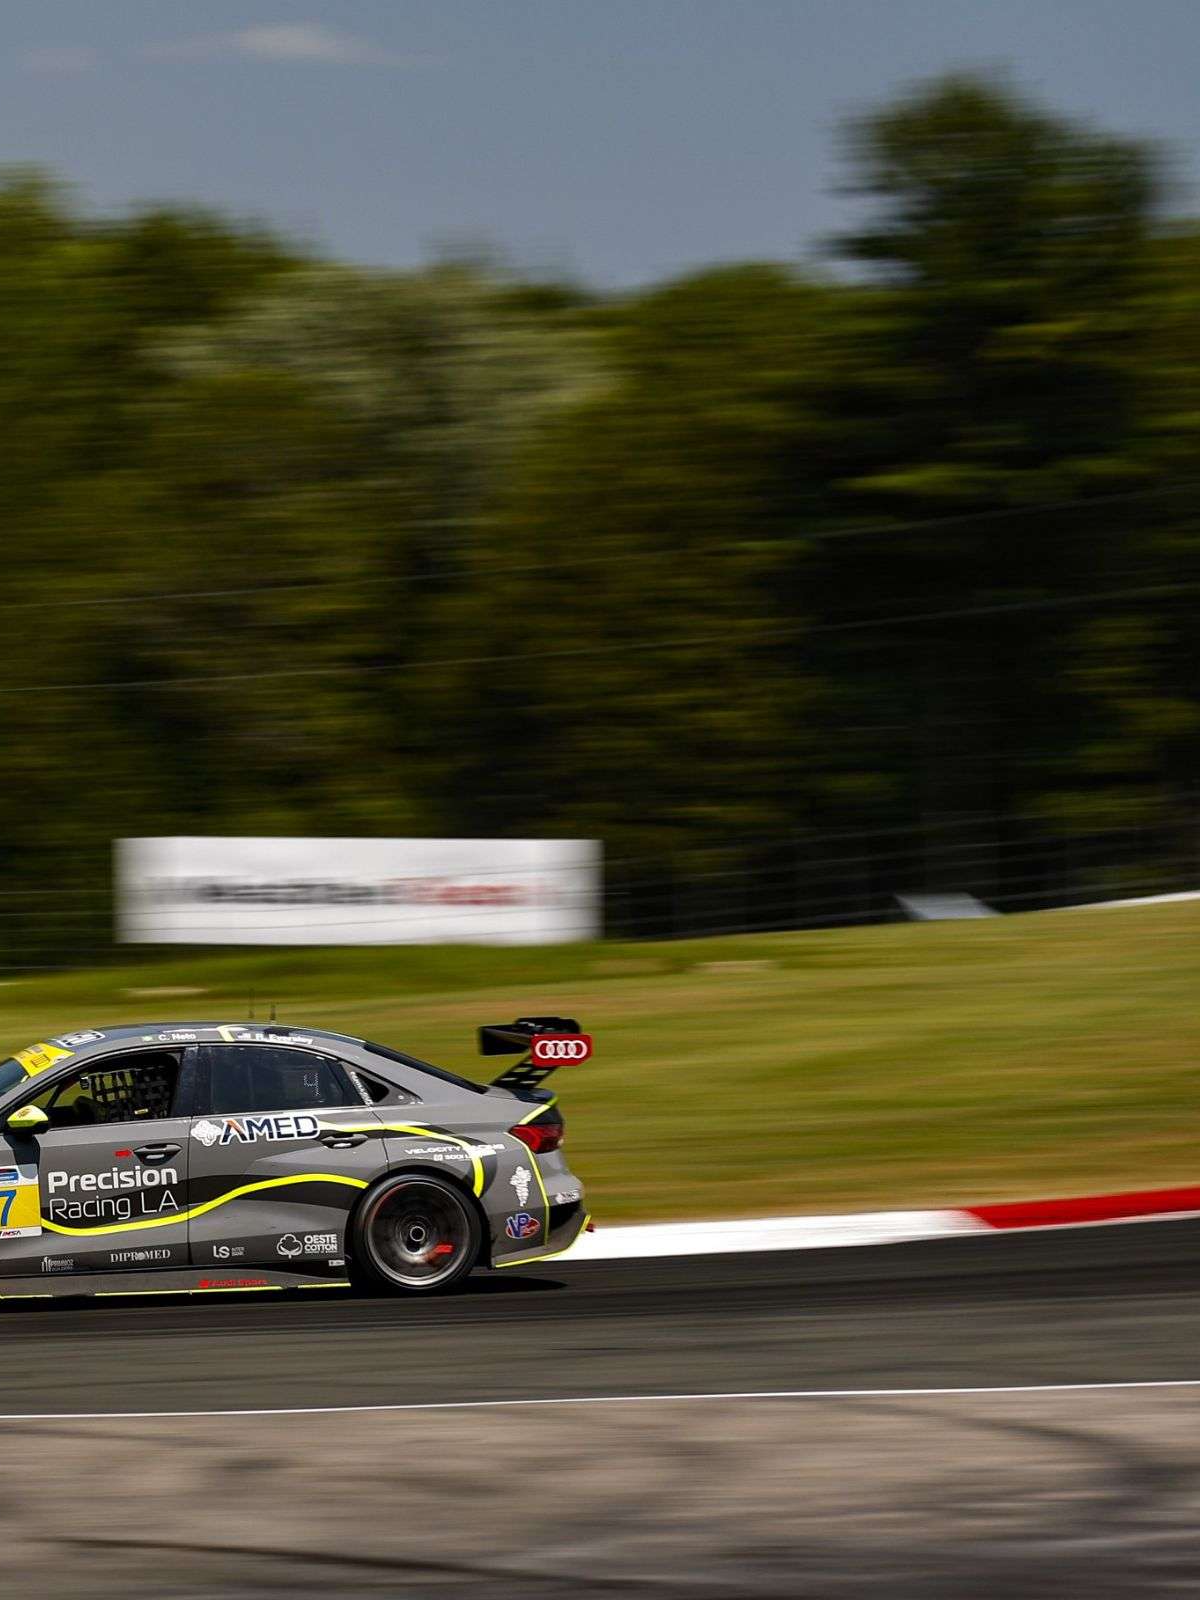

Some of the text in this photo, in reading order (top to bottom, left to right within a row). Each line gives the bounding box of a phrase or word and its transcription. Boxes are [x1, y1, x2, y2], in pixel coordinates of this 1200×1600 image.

[220, 1115, 319, 1143] AMED
[47, 1165, 178, 1194] Precision
[49, 1190, 179, 1221] Racing LA
[304, 1233, 338, 1244] OESTE
[304, 1243, 338, 1251] COTTON
[213, 1245, 230, 1259] LS
